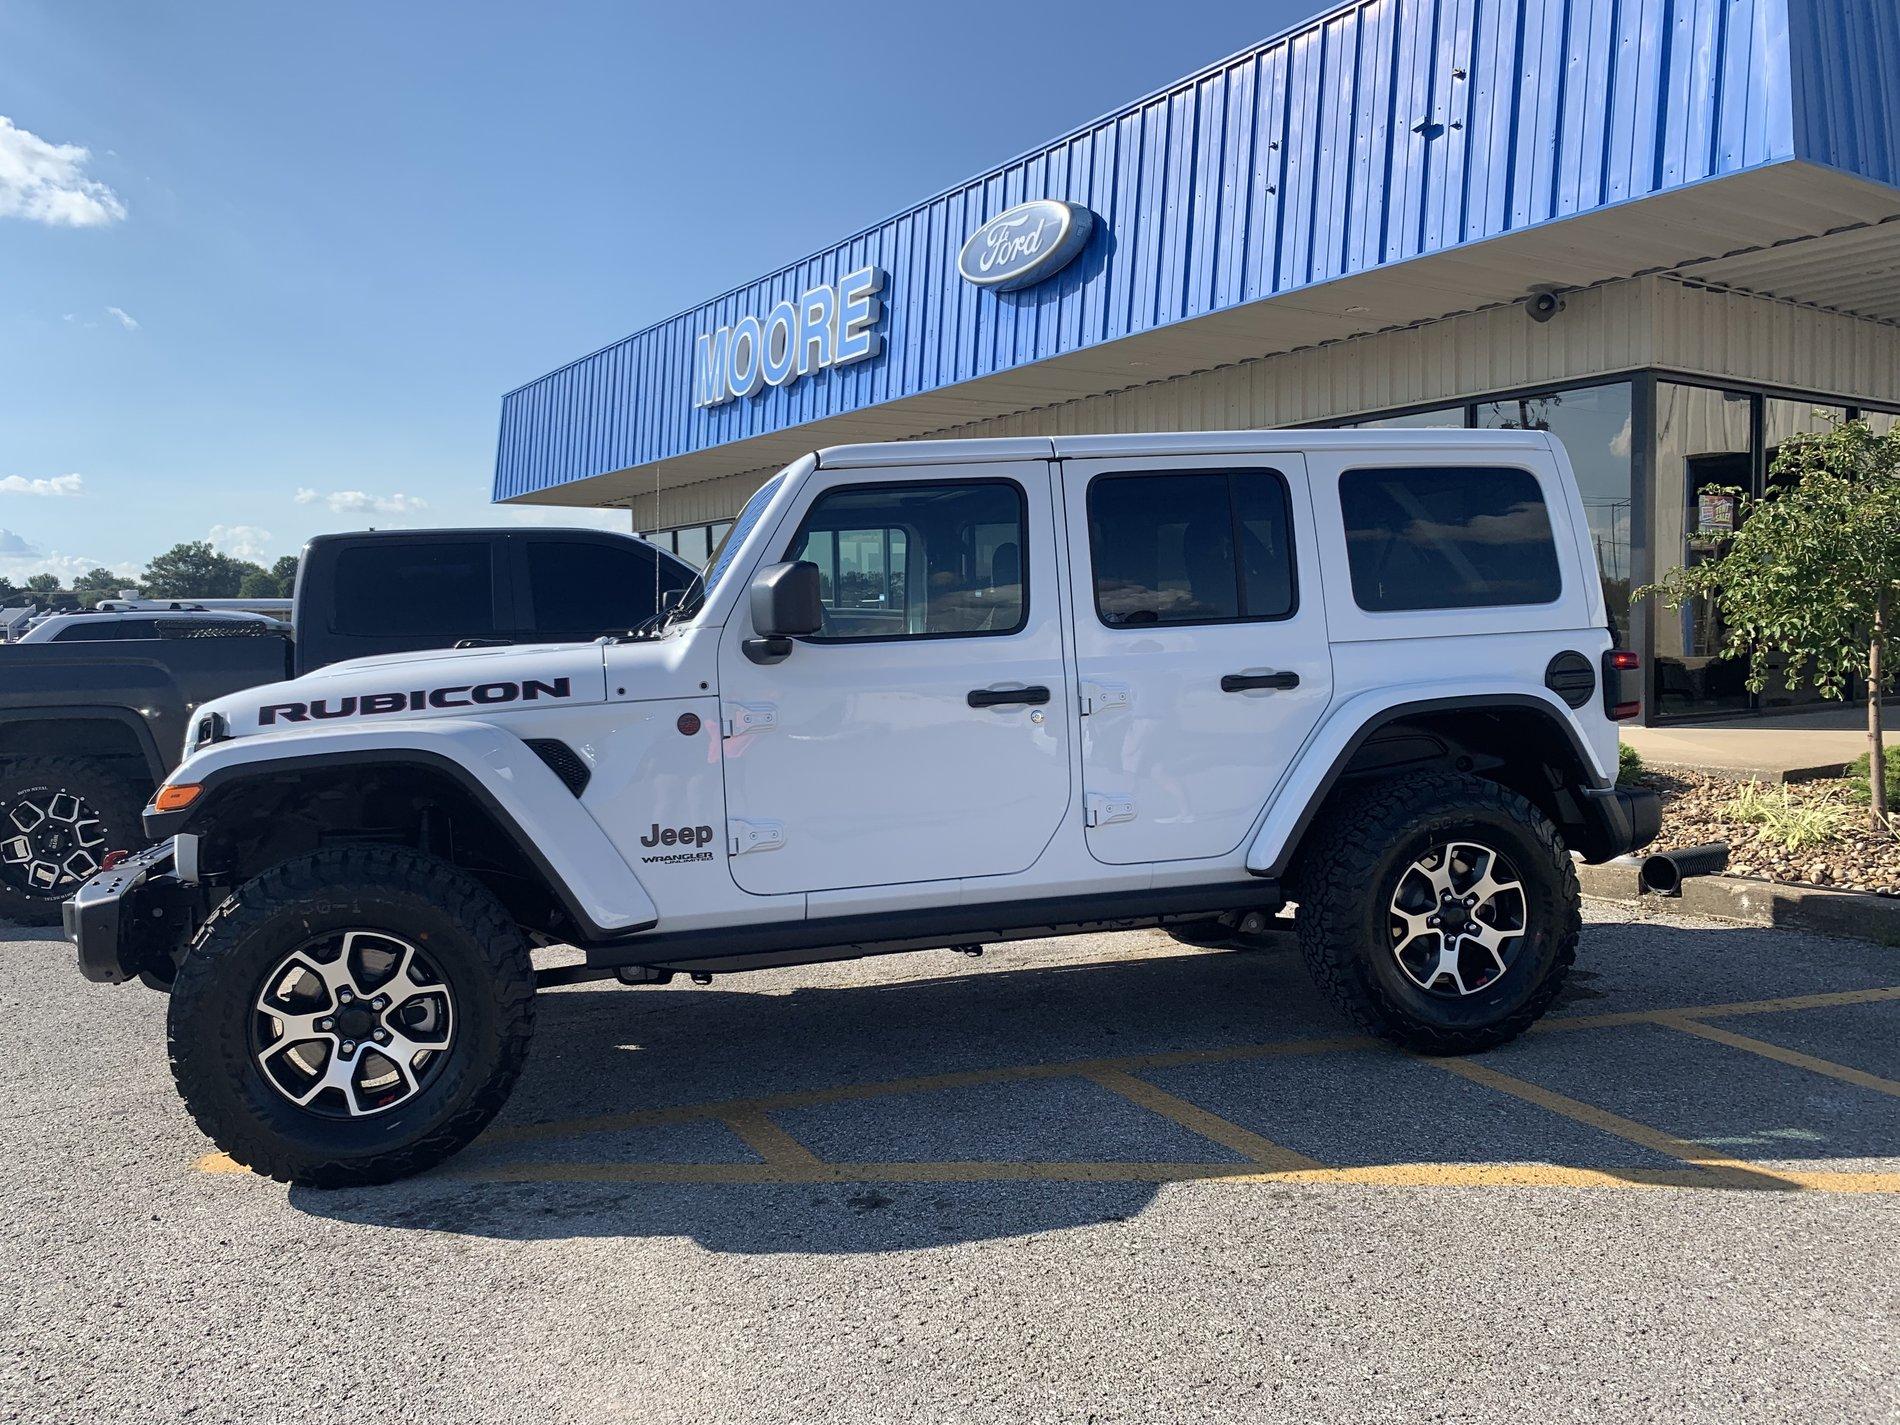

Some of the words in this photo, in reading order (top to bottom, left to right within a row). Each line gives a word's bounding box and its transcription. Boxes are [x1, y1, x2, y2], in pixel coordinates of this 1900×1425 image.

[979, 214, 1045, 272] Ford
[693, 265, 883, 409] MOORE
[258, 677, 571, 726] RUBICON
[640, 823, 713, 848] Jeep
[641, 852, 713, 863] WRANGLER
